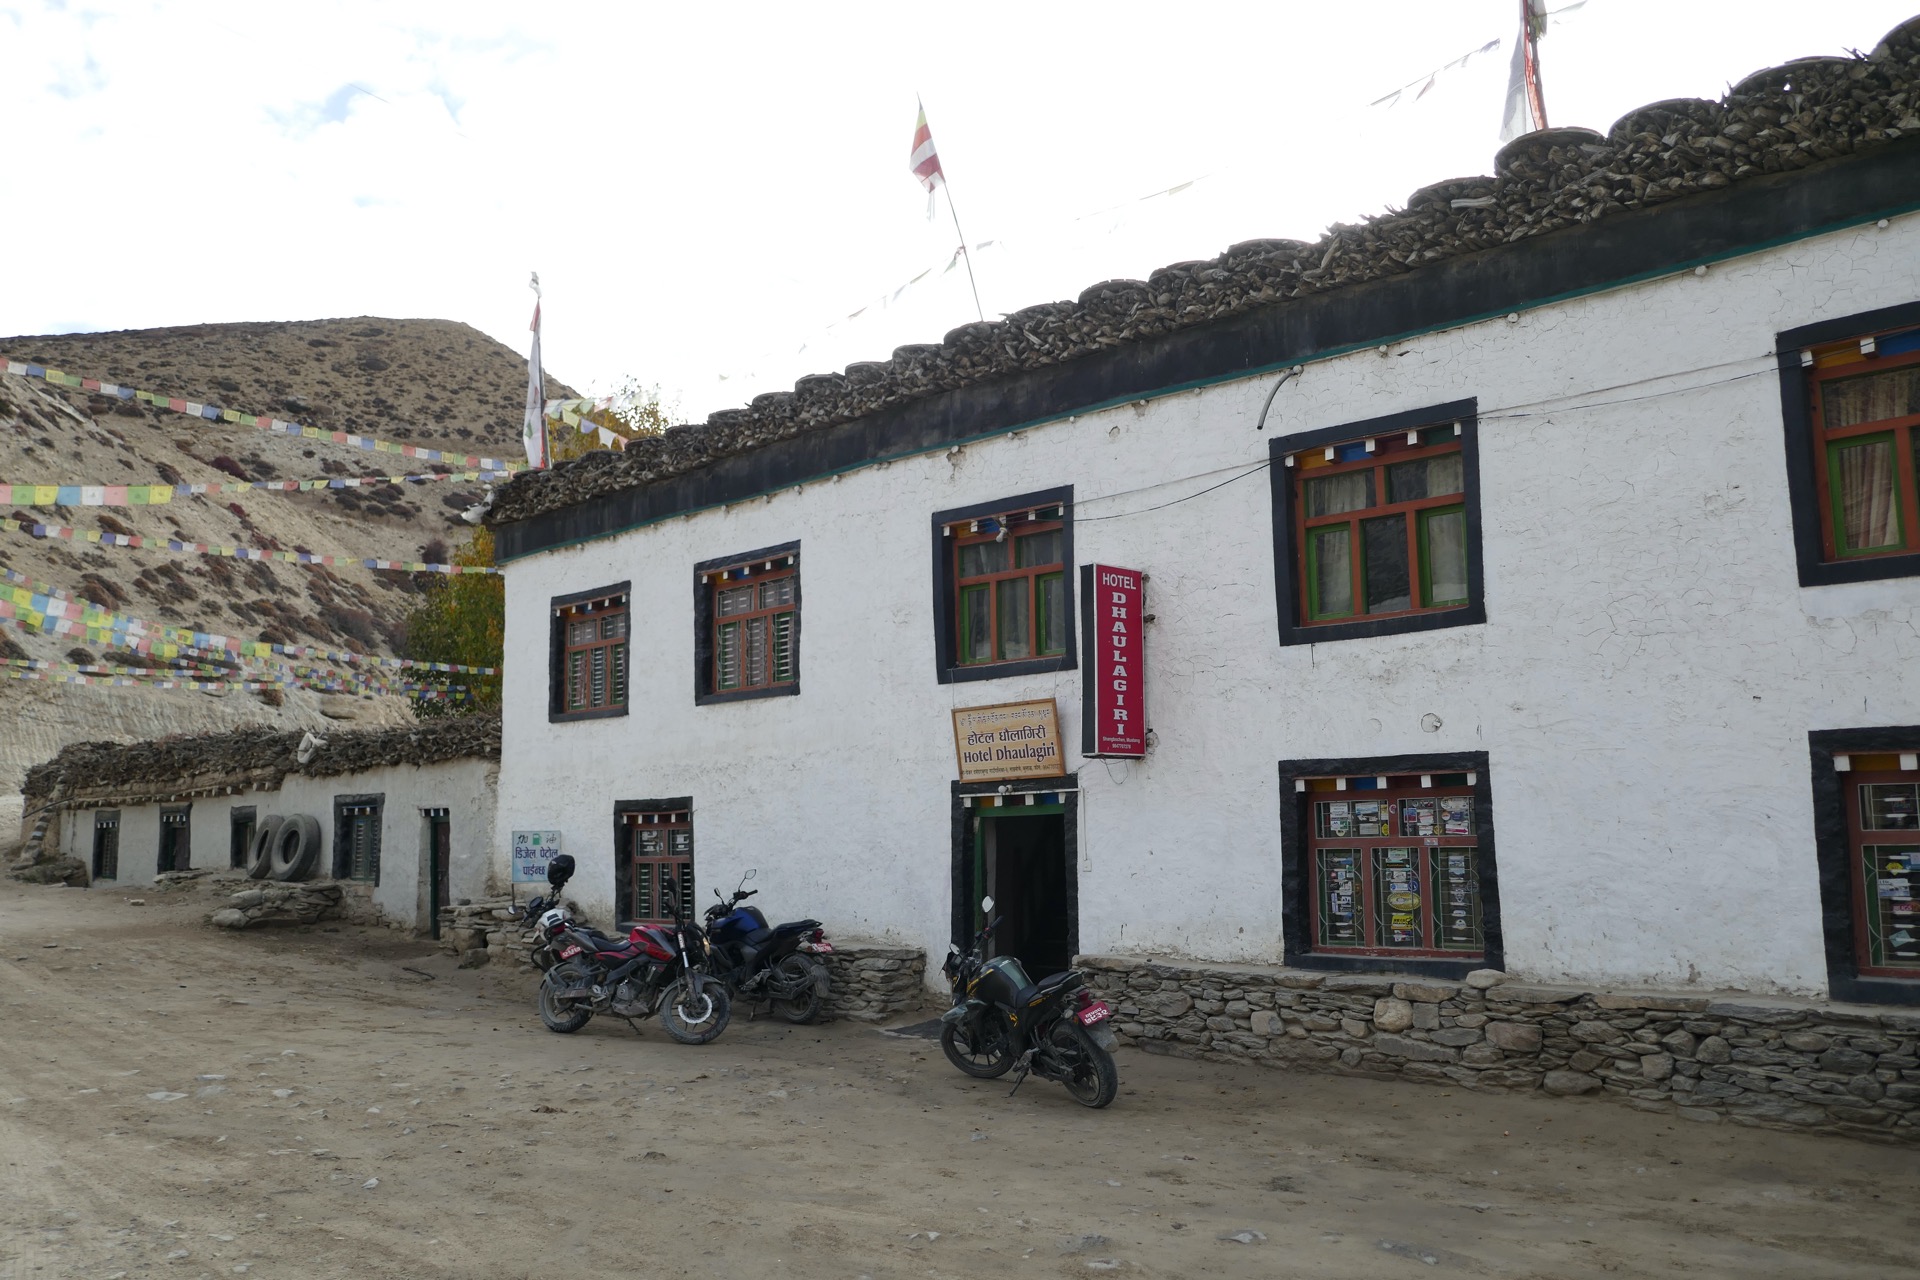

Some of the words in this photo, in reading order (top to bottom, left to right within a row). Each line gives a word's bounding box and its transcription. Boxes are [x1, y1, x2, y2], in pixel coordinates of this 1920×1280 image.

[1102, 573, 1136, 590] HOTEL
[1111, 591, 1128, 735] DHAULAGIRI
[967, 731, 994, 745] होटल
[999, 725, 1046, 742] धौलागिरी
[964, 747, 992, 763] Hotel
[996, 742, 1055, 762] Dhaulagiri
[515, 847, 536, 859] डिजेल
